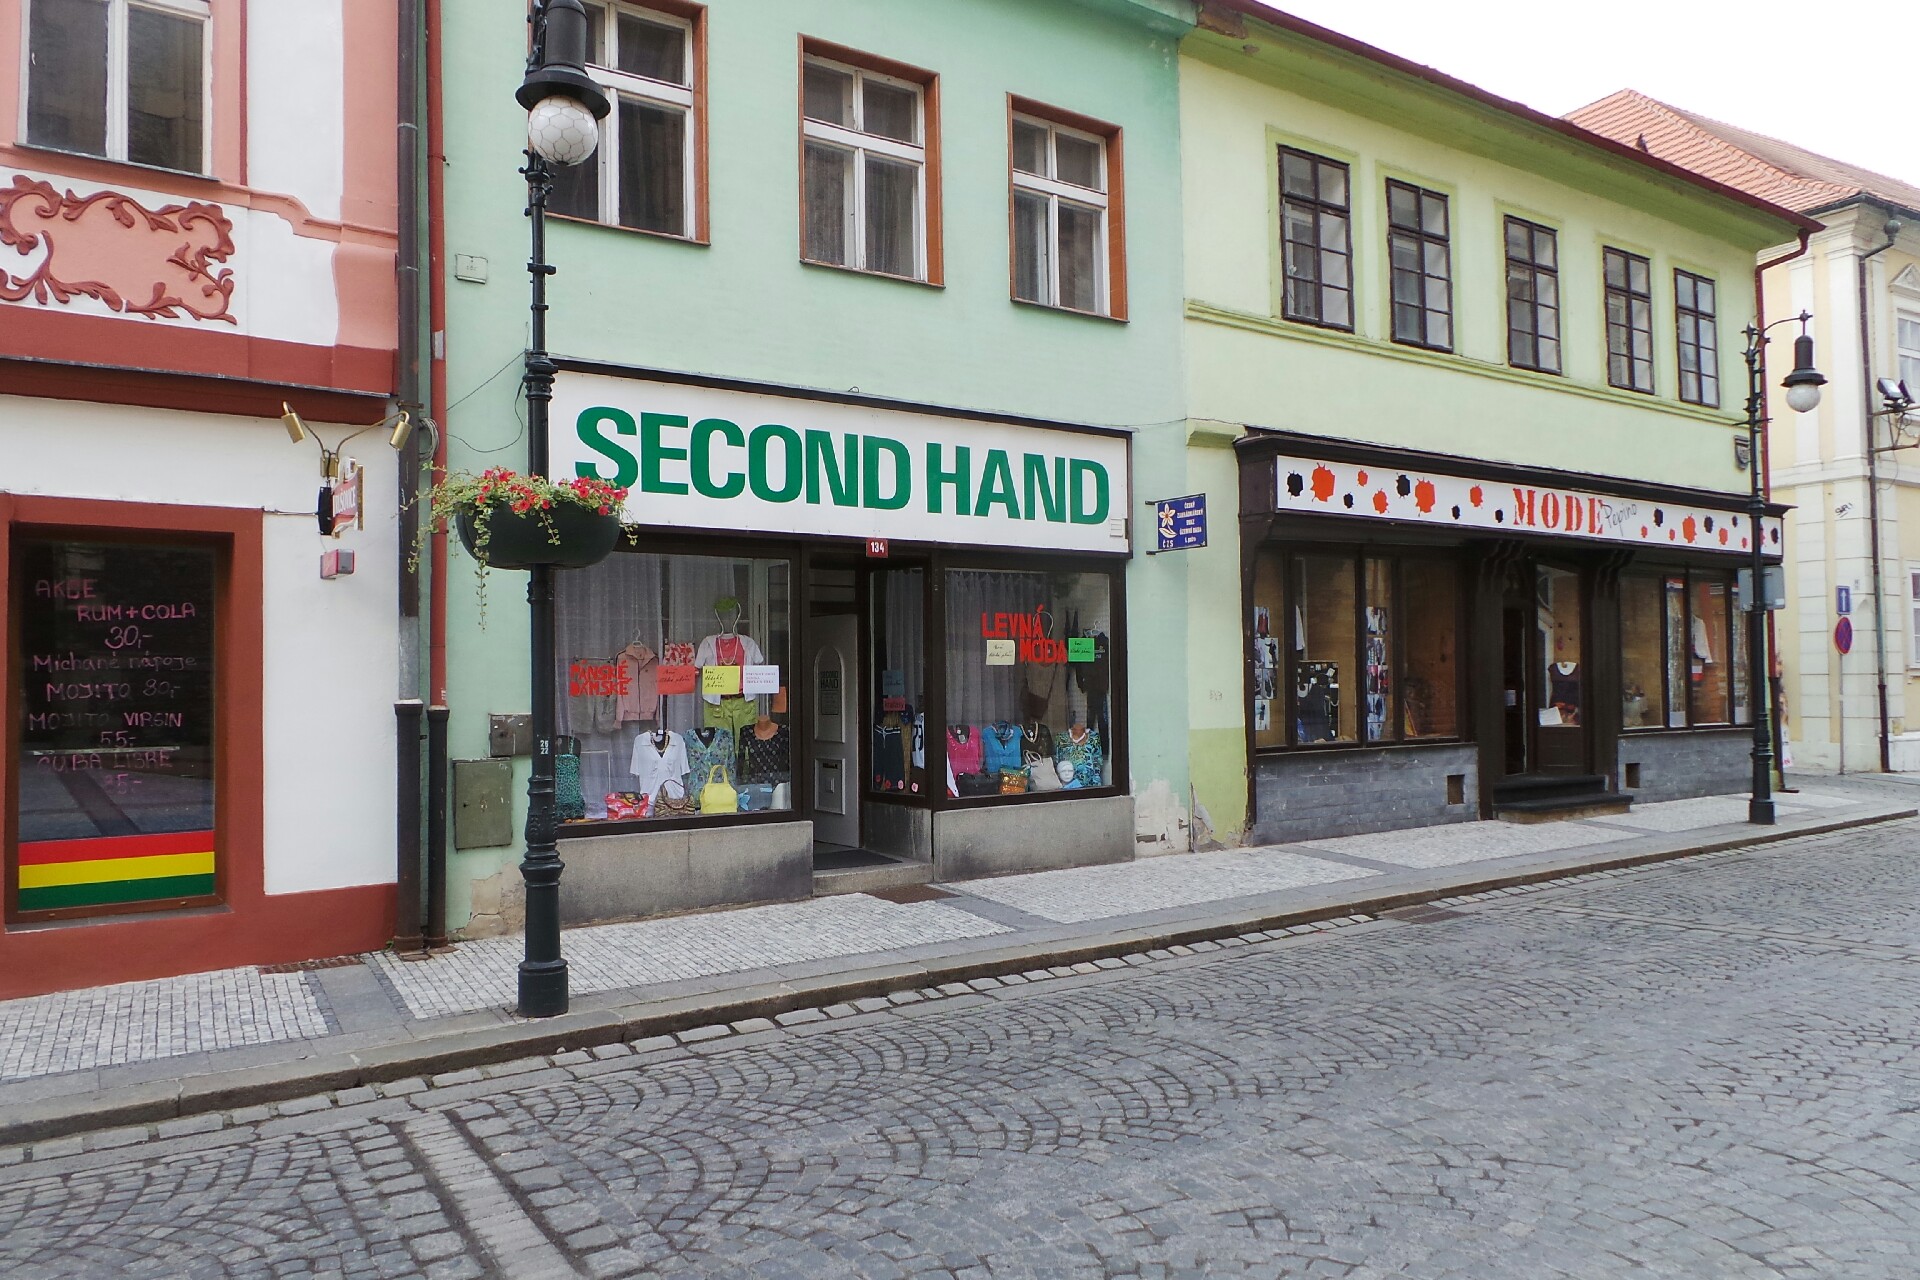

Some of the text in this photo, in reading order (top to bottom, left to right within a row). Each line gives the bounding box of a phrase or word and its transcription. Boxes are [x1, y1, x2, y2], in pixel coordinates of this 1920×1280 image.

[575, 406, 1111, 525] SECOND HAND
[1513, 488, 1604, 534] MODE
[871, 541, 884, 553] 134
[35, 579, 98, 600] AKCE
[982, 604, 1044, 638] LEVNÁ
[46, 683, 131, 702] MOJITO
